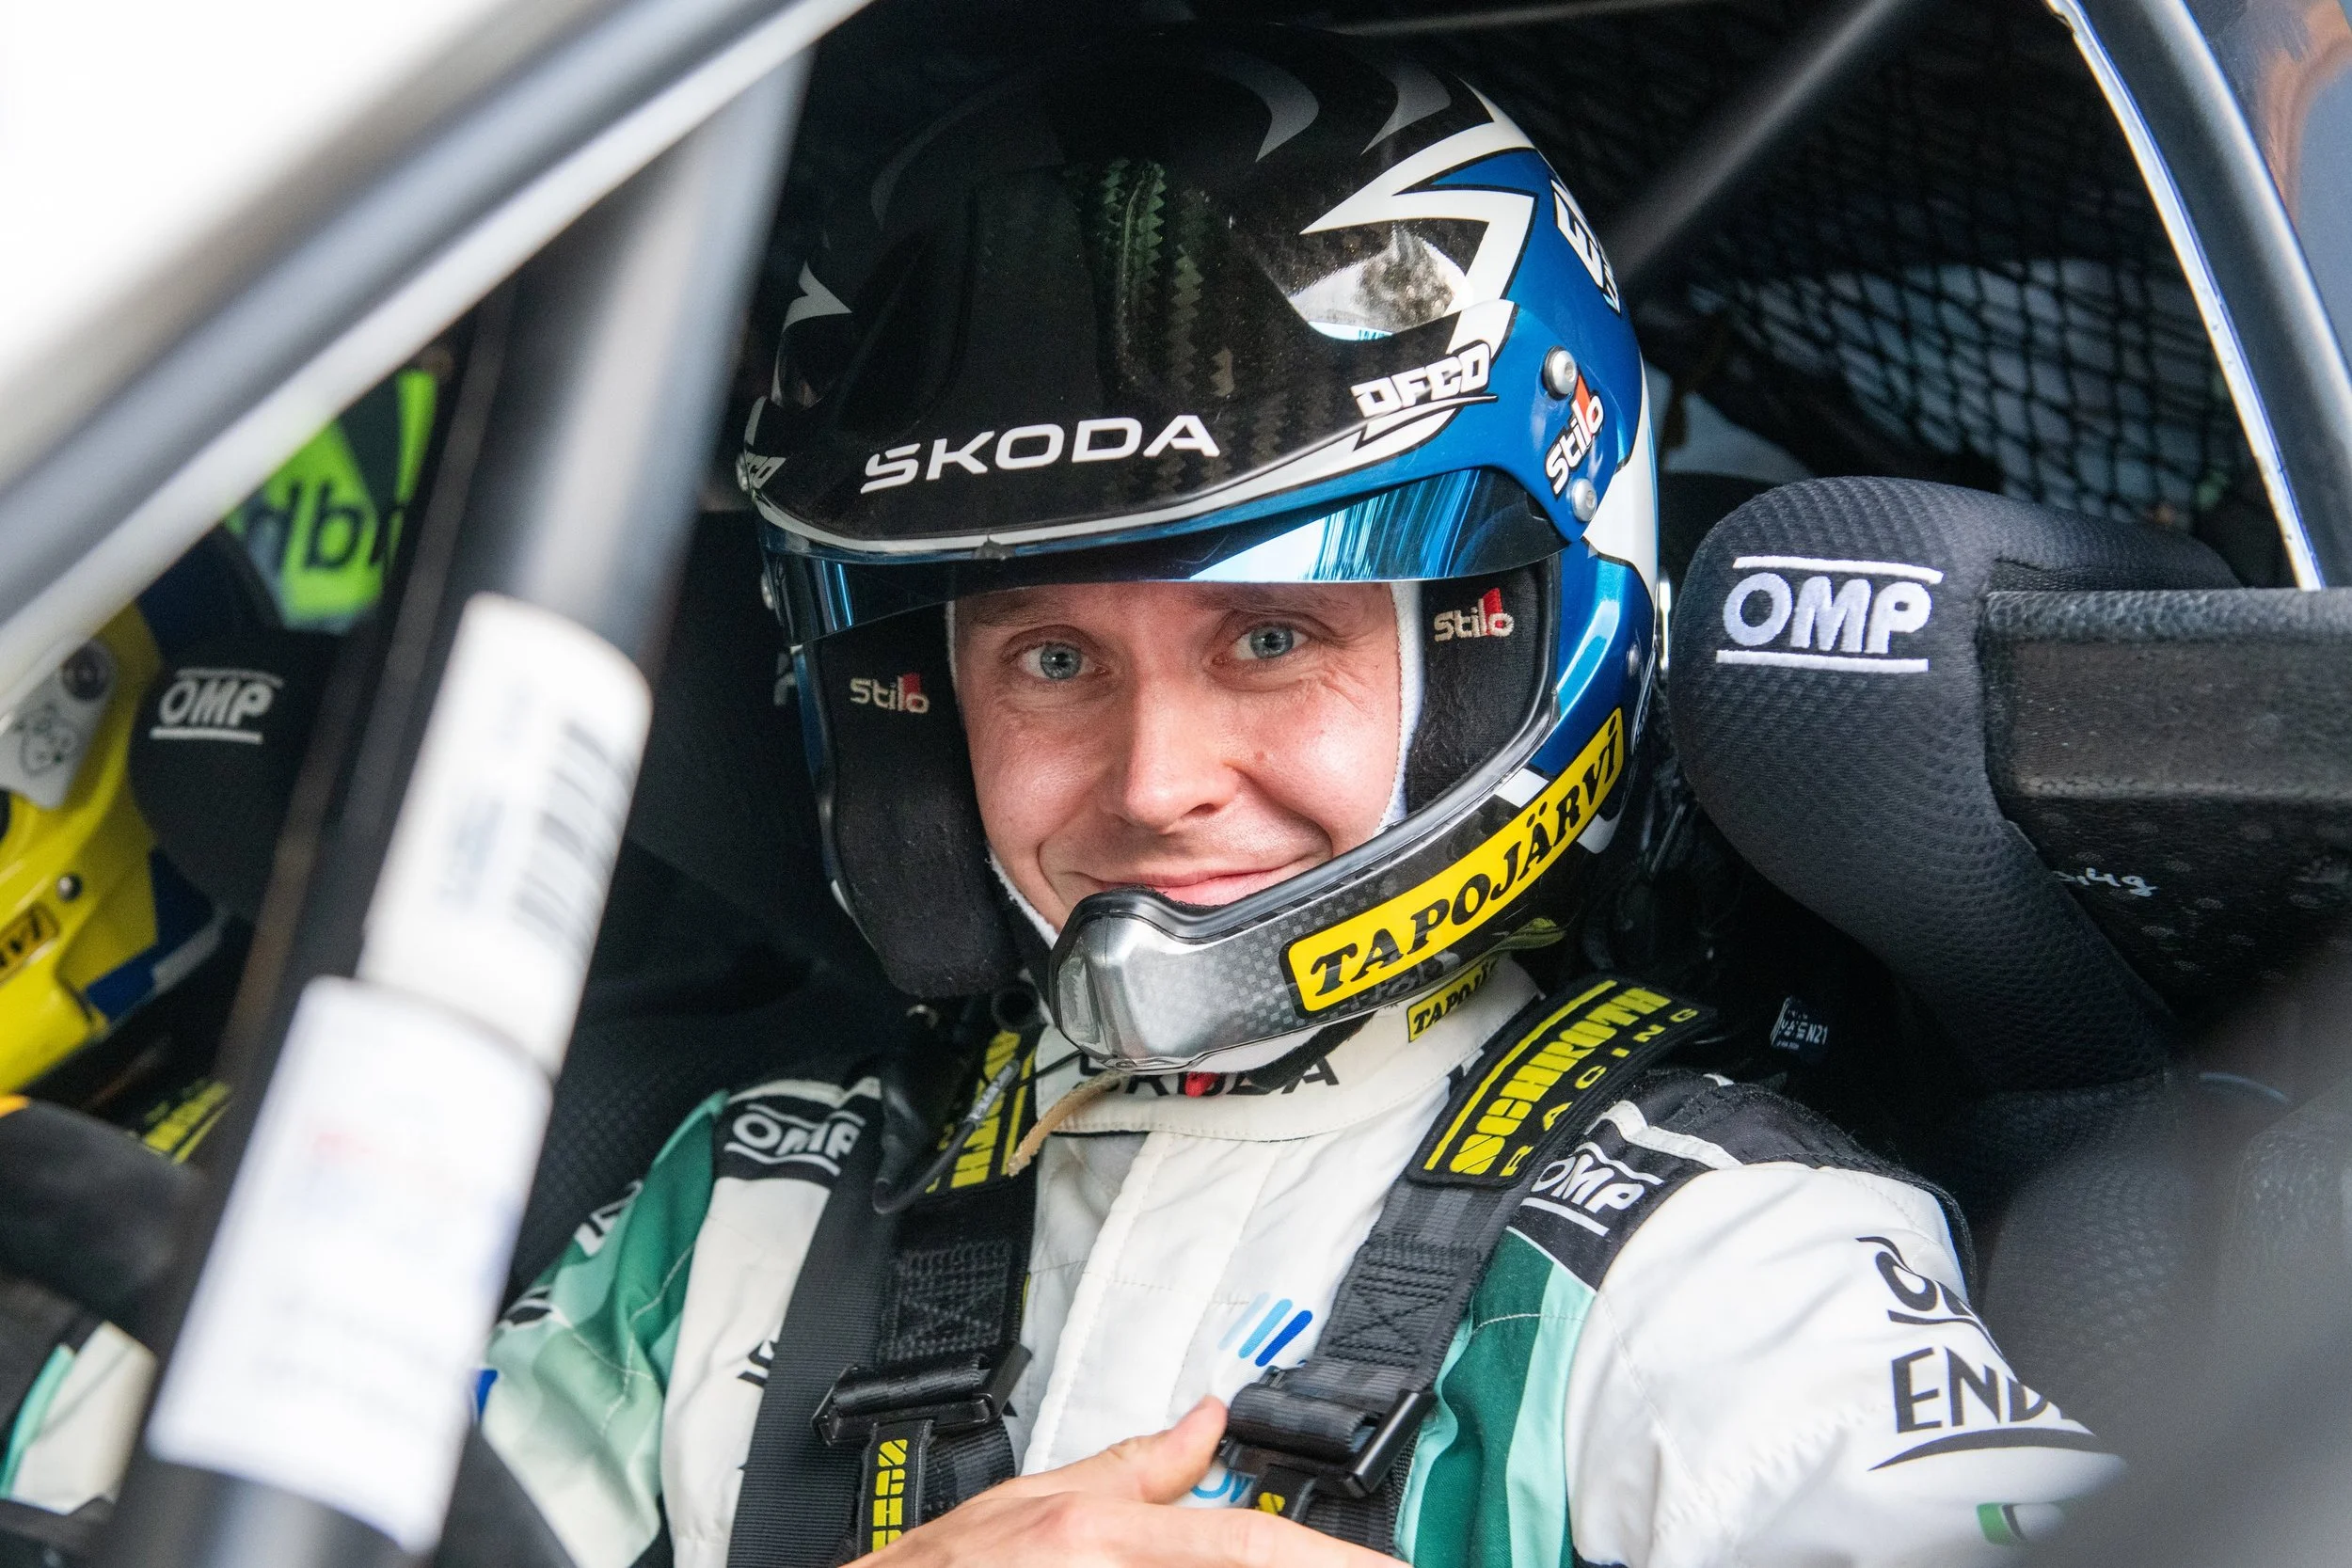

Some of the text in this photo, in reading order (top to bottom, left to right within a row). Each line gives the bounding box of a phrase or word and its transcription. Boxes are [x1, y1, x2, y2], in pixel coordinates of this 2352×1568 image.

[1723, 571, 1932, 655] OMP
[158, 677, 274, 726] OMP
[1449, 987, 1672, 1176] SCHROTH
[1531, 1153, 1645, 1214] OMP
